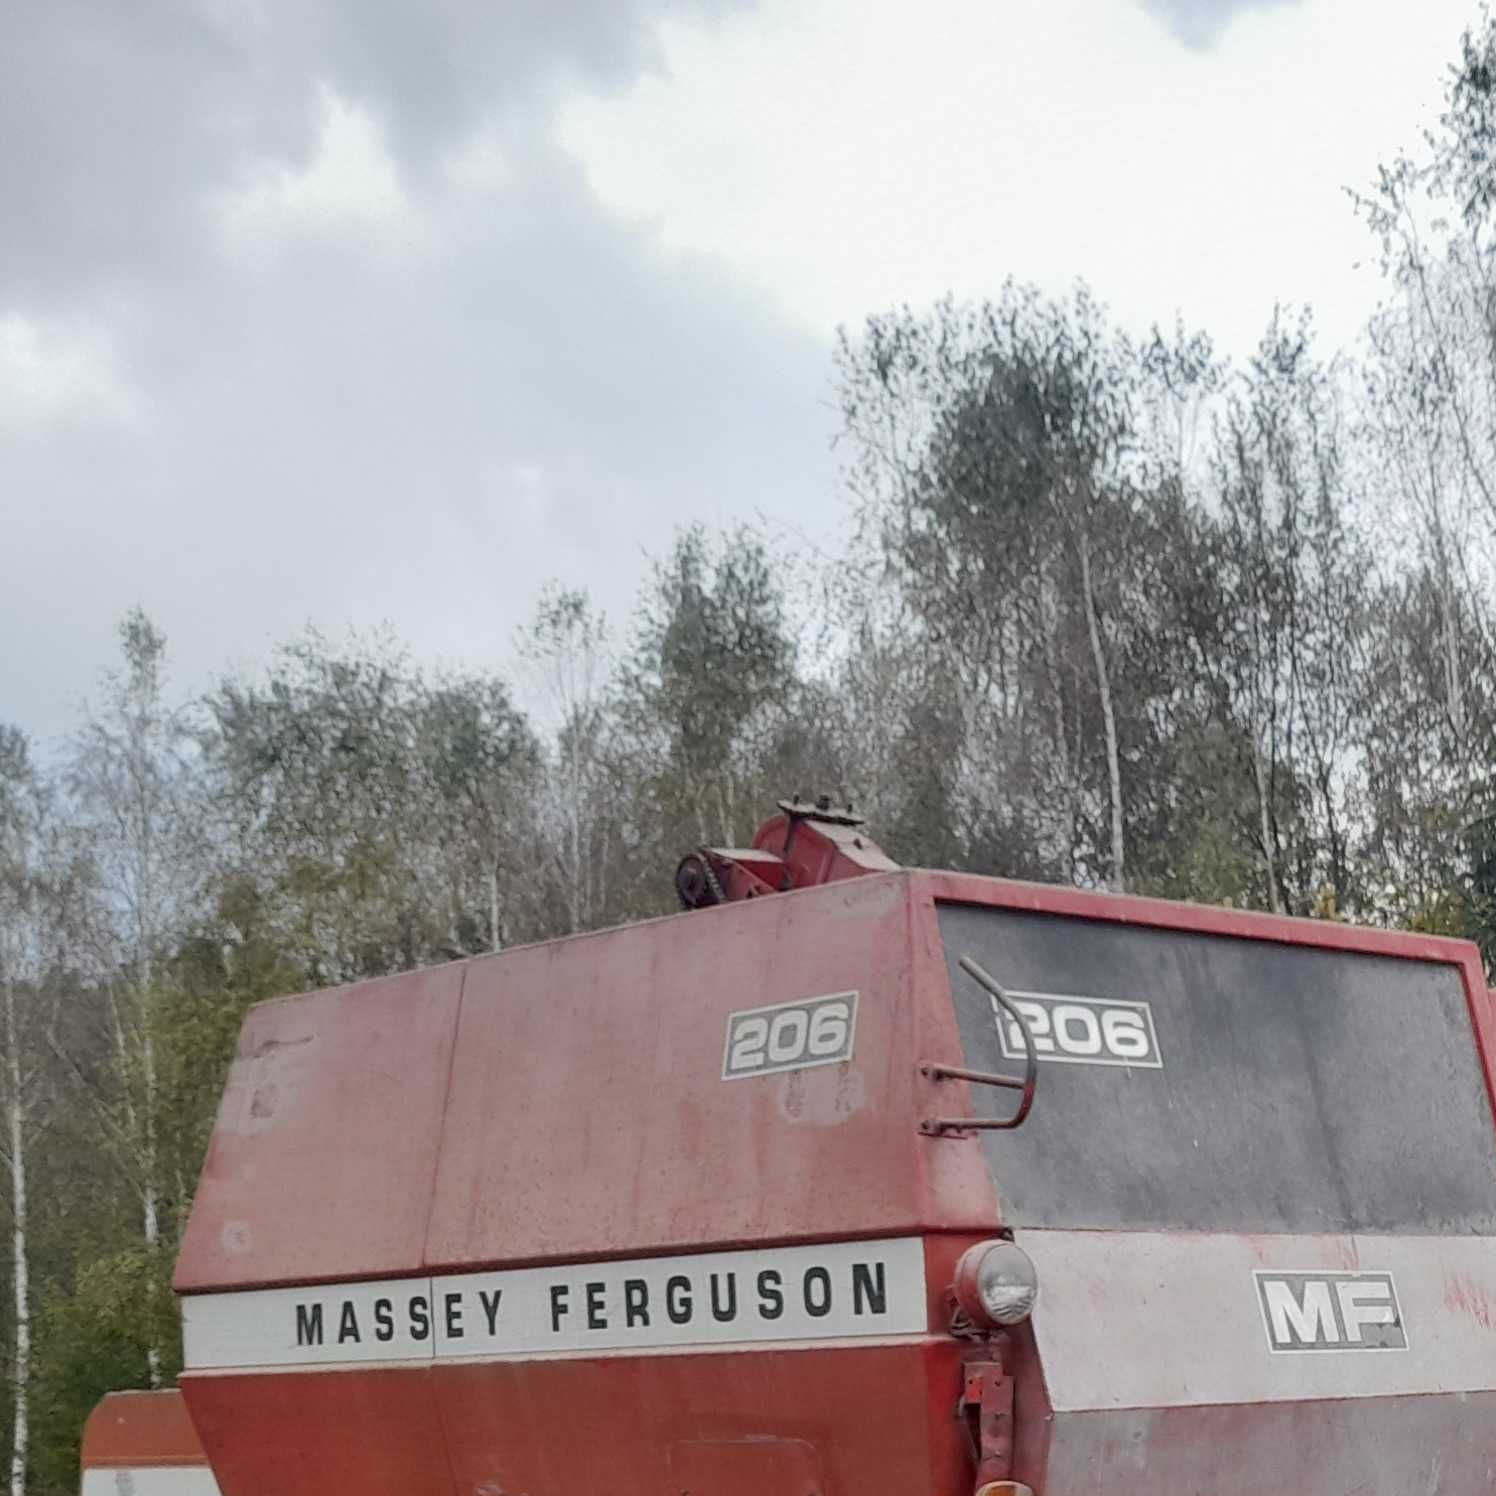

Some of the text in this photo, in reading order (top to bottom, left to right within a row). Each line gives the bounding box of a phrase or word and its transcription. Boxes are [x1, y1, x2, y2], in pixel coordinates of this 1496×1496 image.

[730, 1002, 849, 1070] 206
[1003, 1001, 1149, 1058] 206
[296, 1262, 887, 1346] MASSEY FERGUSON
[1263, 1280, 1395, 1344] MF
